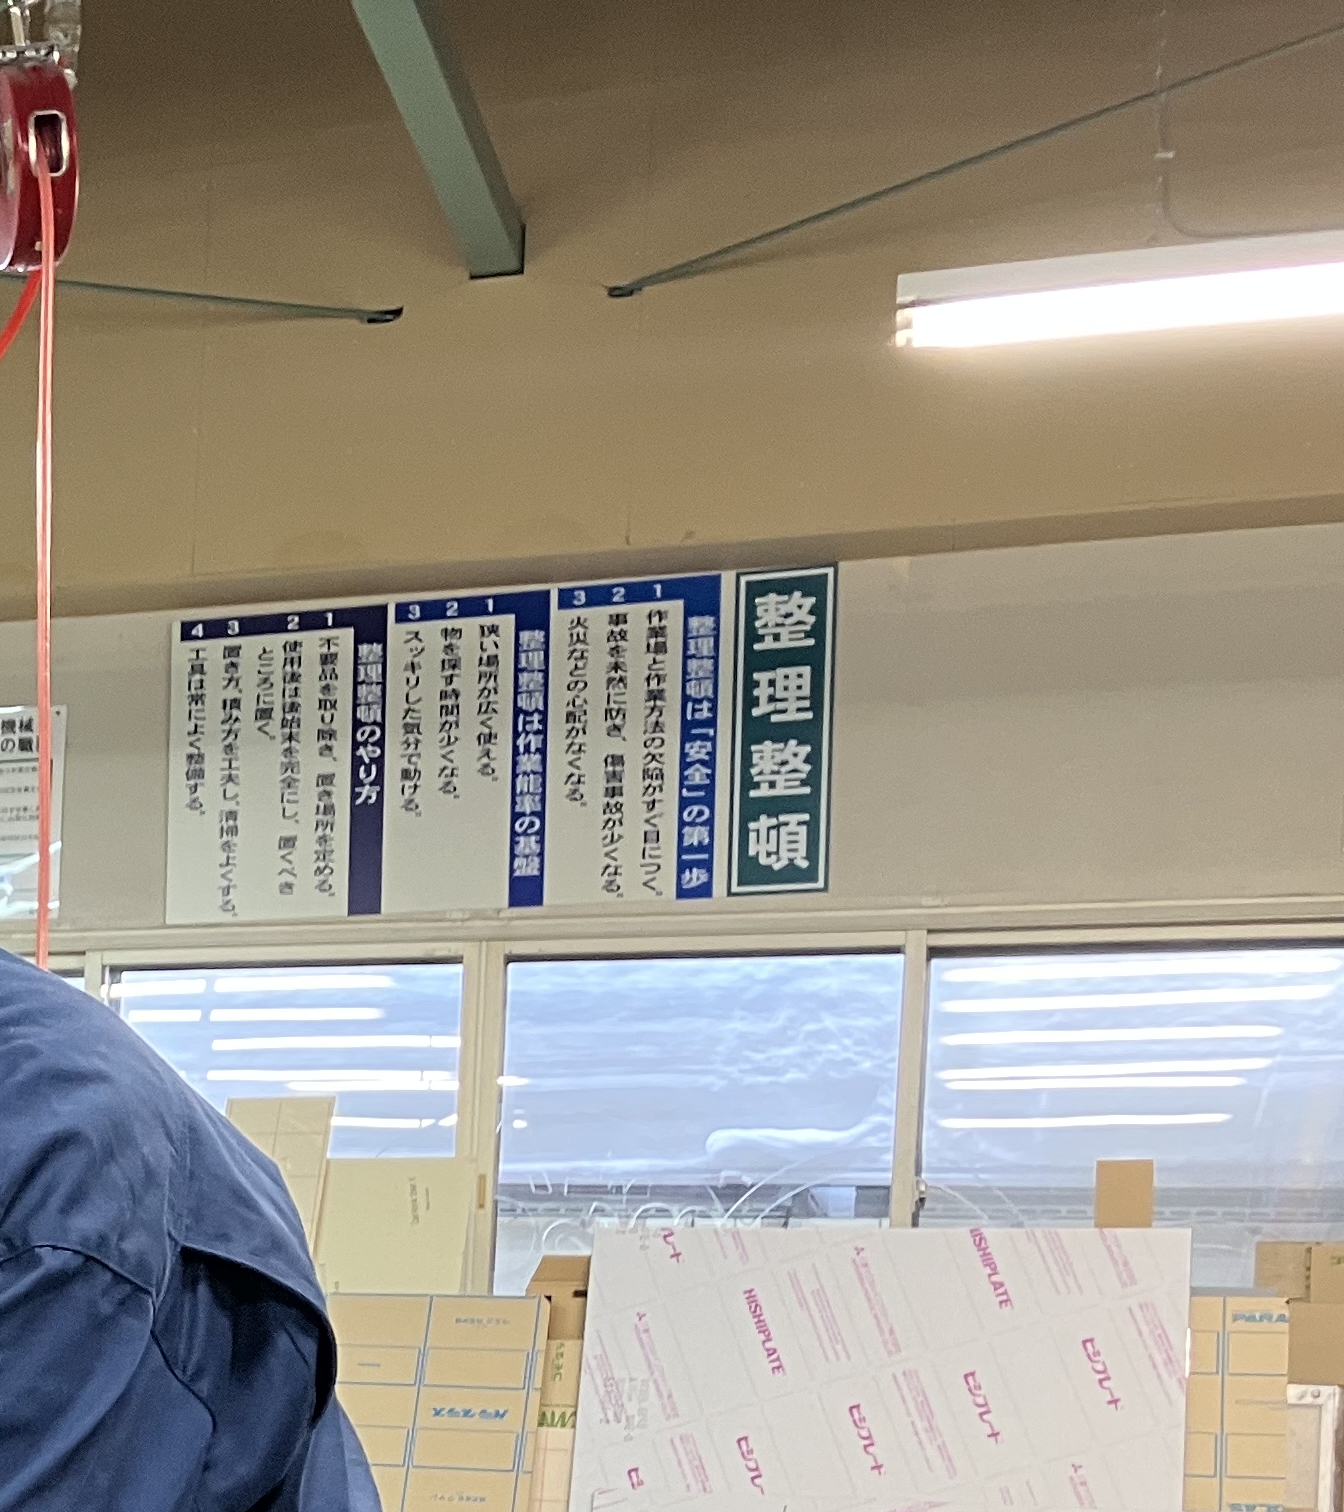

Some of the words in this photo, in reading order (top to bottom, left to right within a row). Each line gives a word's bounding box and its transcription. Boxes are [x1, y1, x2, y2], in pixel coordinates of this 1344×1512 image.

[611, 586, 626, 603] 2
[652, 583, 663, 599] 1
[445, 600, 460, 617] 2
[485, 597, 495, 614] 1
[286, 614, 301, 631] 2
[323, 611, 334, 628] 1
[190, 622, 205, 639] 4
[354, 642, 384, 806] 整理整頓のやり方
[747, 590, 817, 871] 整理整頓
[742, 1286, 787, 1377] HISHIPLATE
